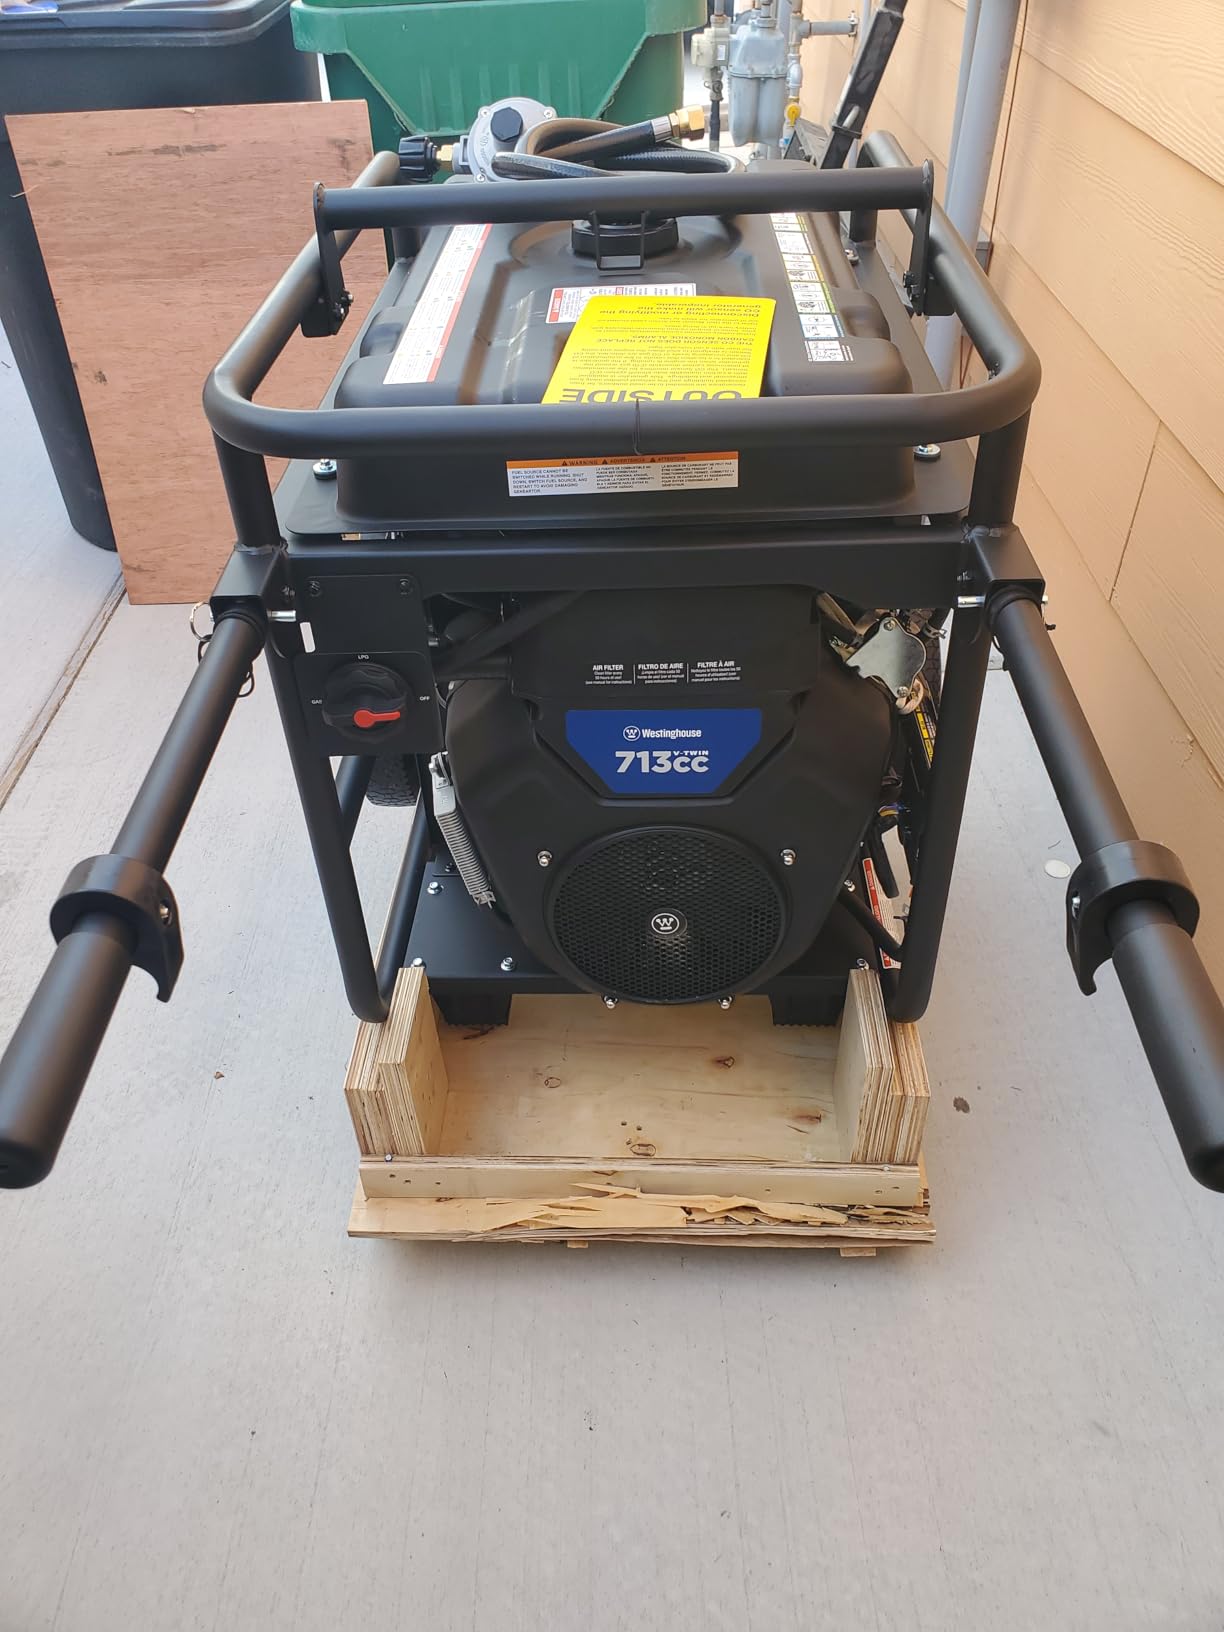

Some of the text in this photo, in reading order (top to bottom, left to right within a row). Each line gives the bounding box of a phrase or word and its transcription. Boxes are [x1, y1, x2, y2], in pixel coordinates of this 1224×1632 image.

[559, 388, 742, 403] OUTSIDE
[641, 728, 702, 739] Westinghouse
[615, 751, 709, 773] 713cc
